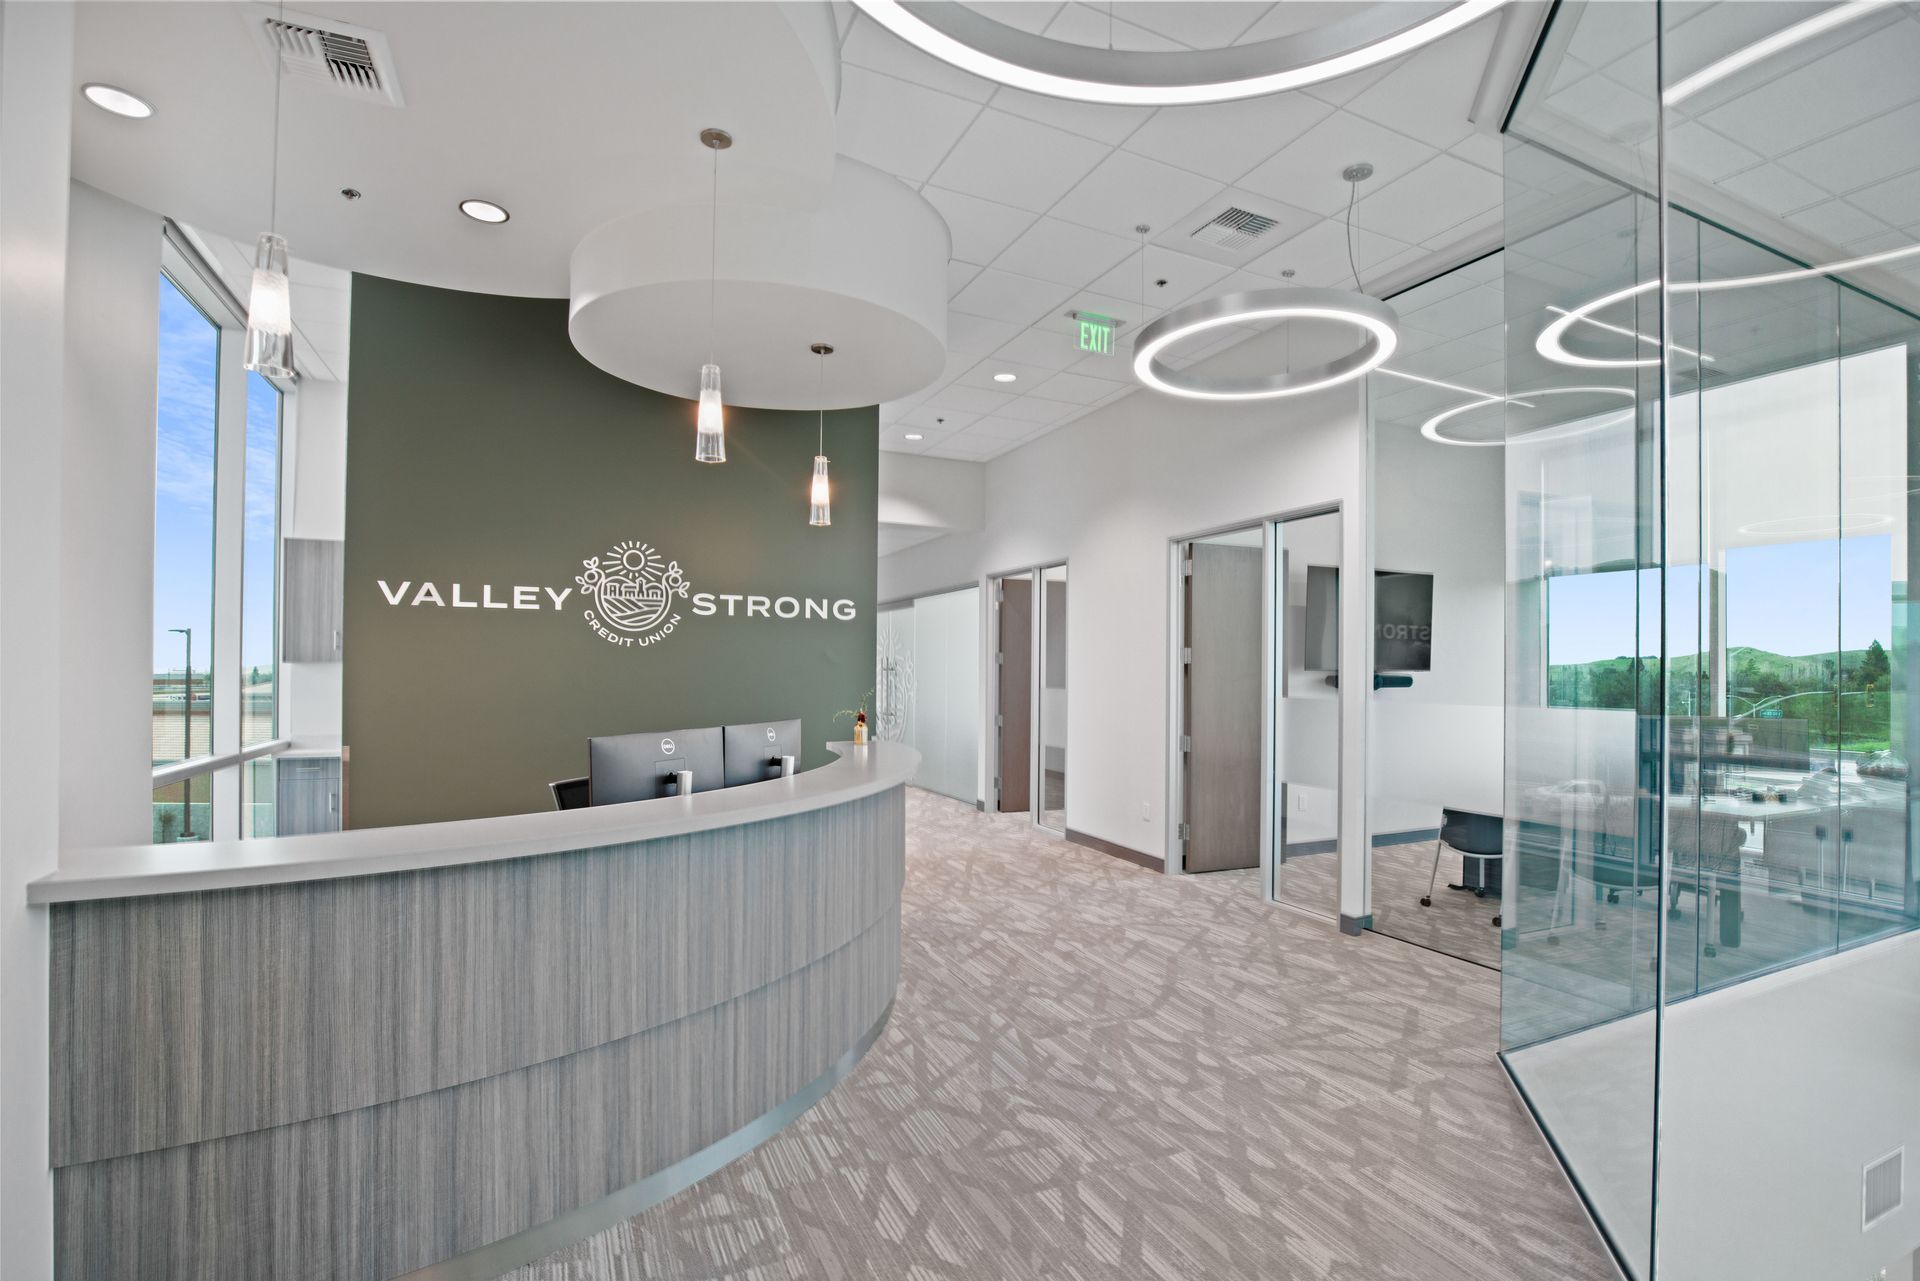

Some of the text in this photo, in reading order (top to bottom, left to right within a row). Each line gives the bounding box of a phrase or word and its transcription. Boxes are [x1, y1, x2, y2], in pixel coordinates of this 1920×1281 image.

[1080, 322, 1110, 353] EXIT
[377, 580, 856, 620] VALLEY STRONG
[584, 610, 681, 647] CREDIT UNION
